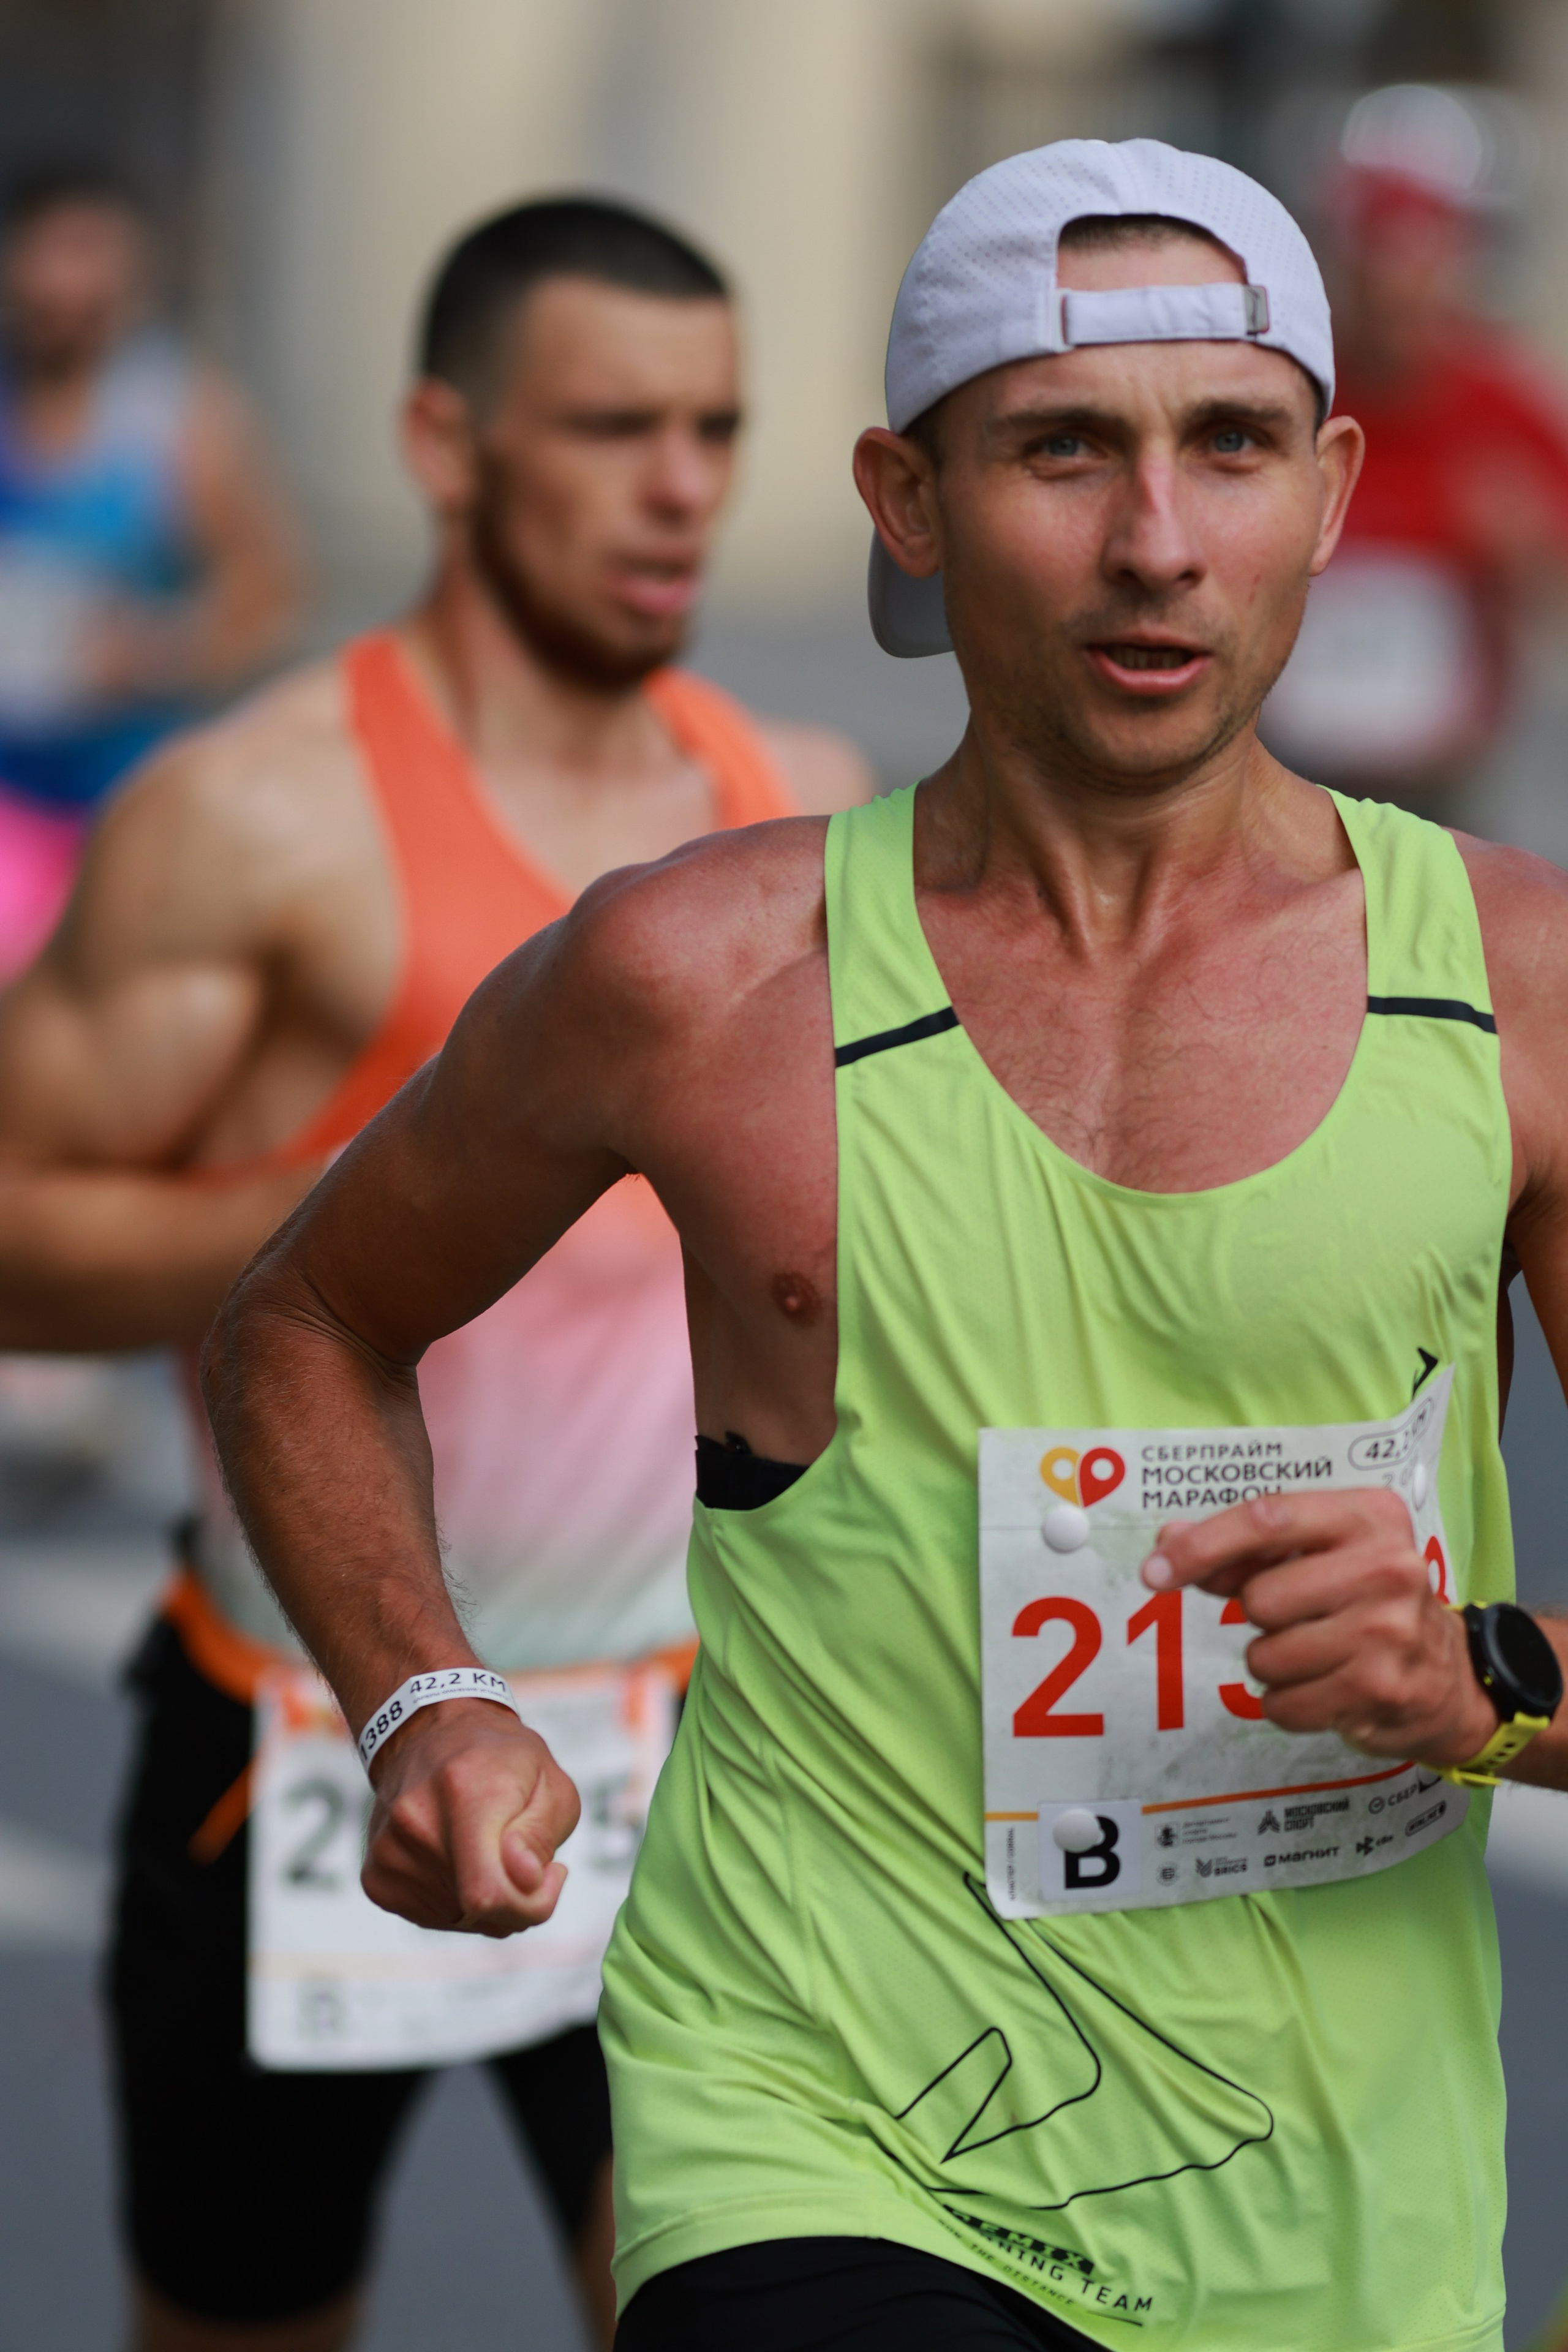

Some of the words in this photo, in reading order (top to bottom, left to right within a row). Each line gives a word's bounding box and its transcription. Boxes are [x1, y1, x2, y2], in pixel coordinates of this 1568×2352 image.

[1142, 1441, 1282, 1461] СБЕРПРАЙМ
[1142, 1456, 1332, 1485] МОСКОВСКИЙ
[410, 1673, 461, 1694] 42,2
[970, 2243, 995, 2261] THE
[1001, 2264, 1074, 2306] DISTANCE
[1081, 2275, 1153, 2312] TEAM
